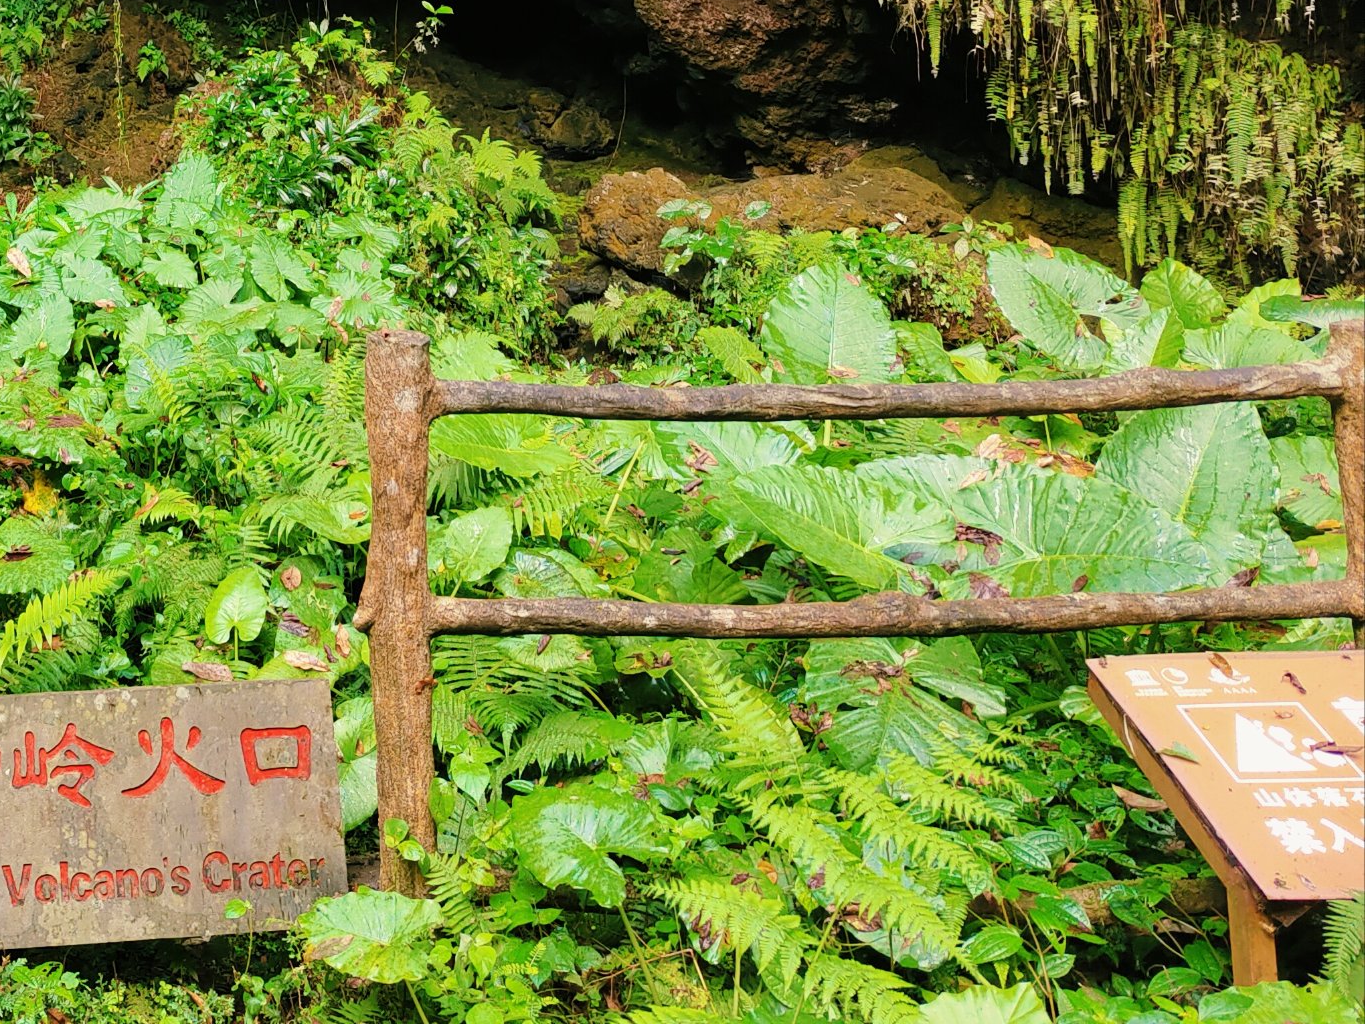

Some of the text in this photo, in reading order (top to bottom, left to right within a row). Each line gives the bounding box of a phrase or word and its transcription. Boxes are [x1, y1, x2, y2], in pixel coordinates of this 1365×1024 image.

[1264, 817, 1365, 855] 禁入
[1, 855, 192, 906] Volcano's
[202, 850, 326, 894] Crater
